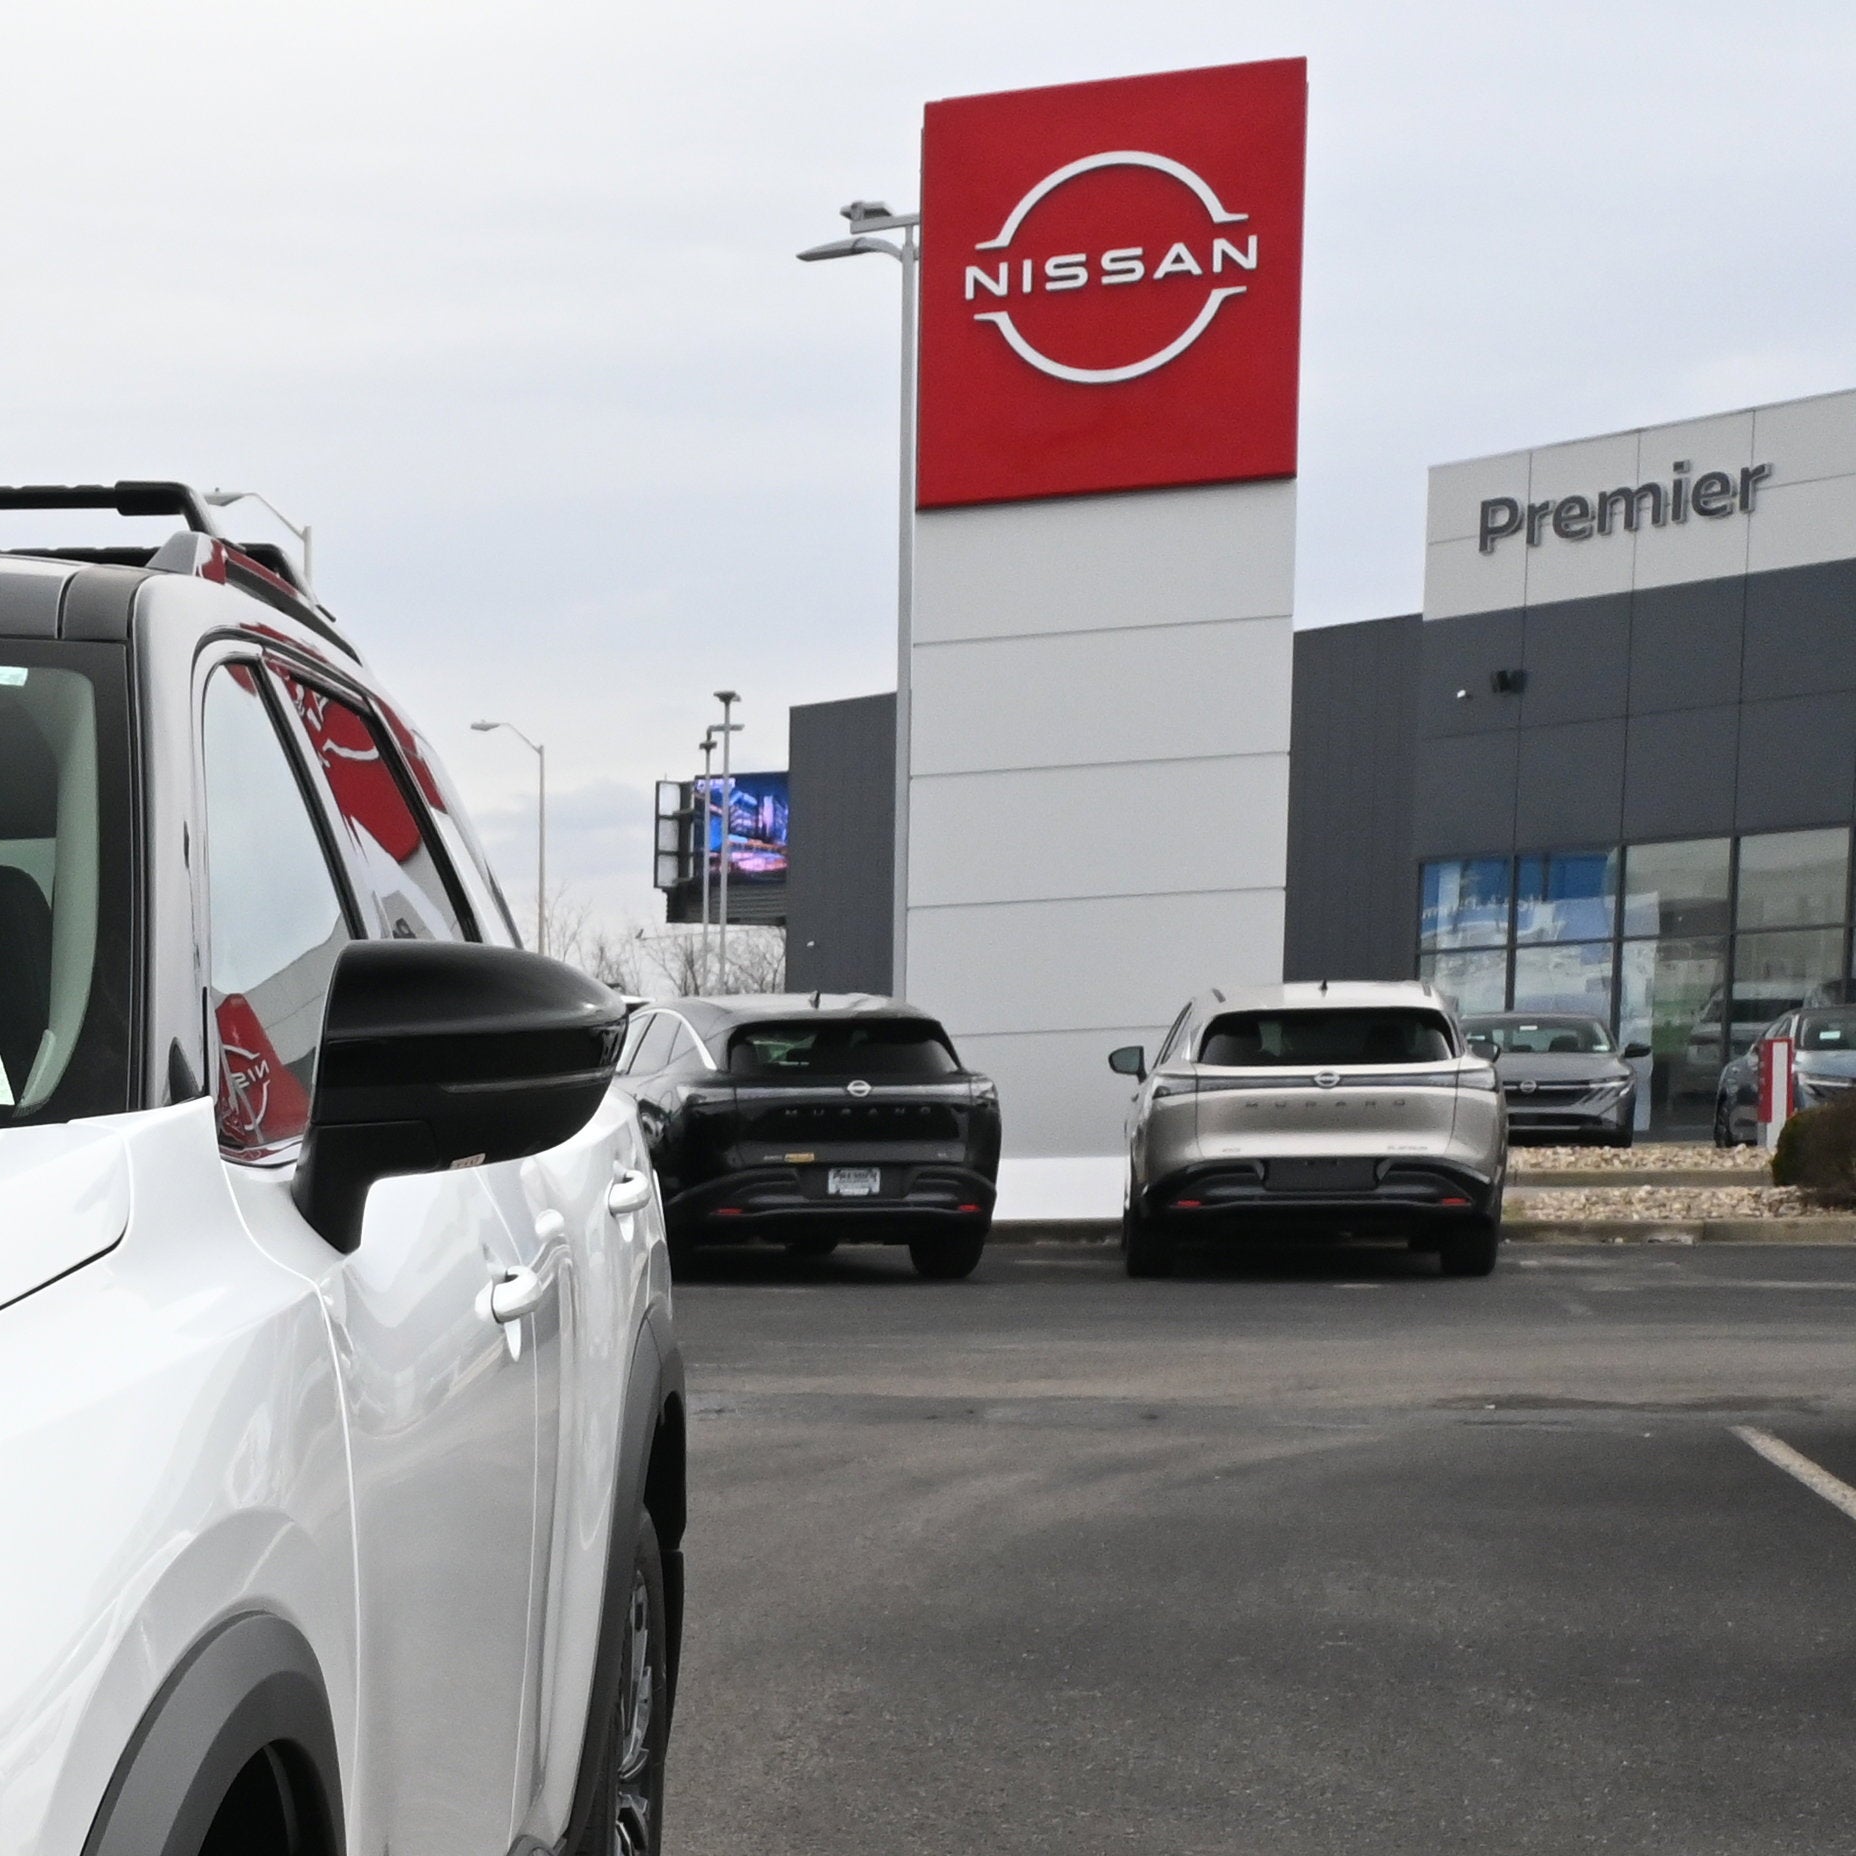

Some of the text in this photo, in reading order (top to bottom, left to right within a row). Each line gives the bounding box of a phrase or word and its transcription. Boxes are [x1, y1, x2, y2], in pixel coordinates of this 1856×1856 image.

[964, 234, 1258, 301] NISSAN
[1478, 459, 1774, 556] Premier
[784, 1105, 932, 1117] MURANO
